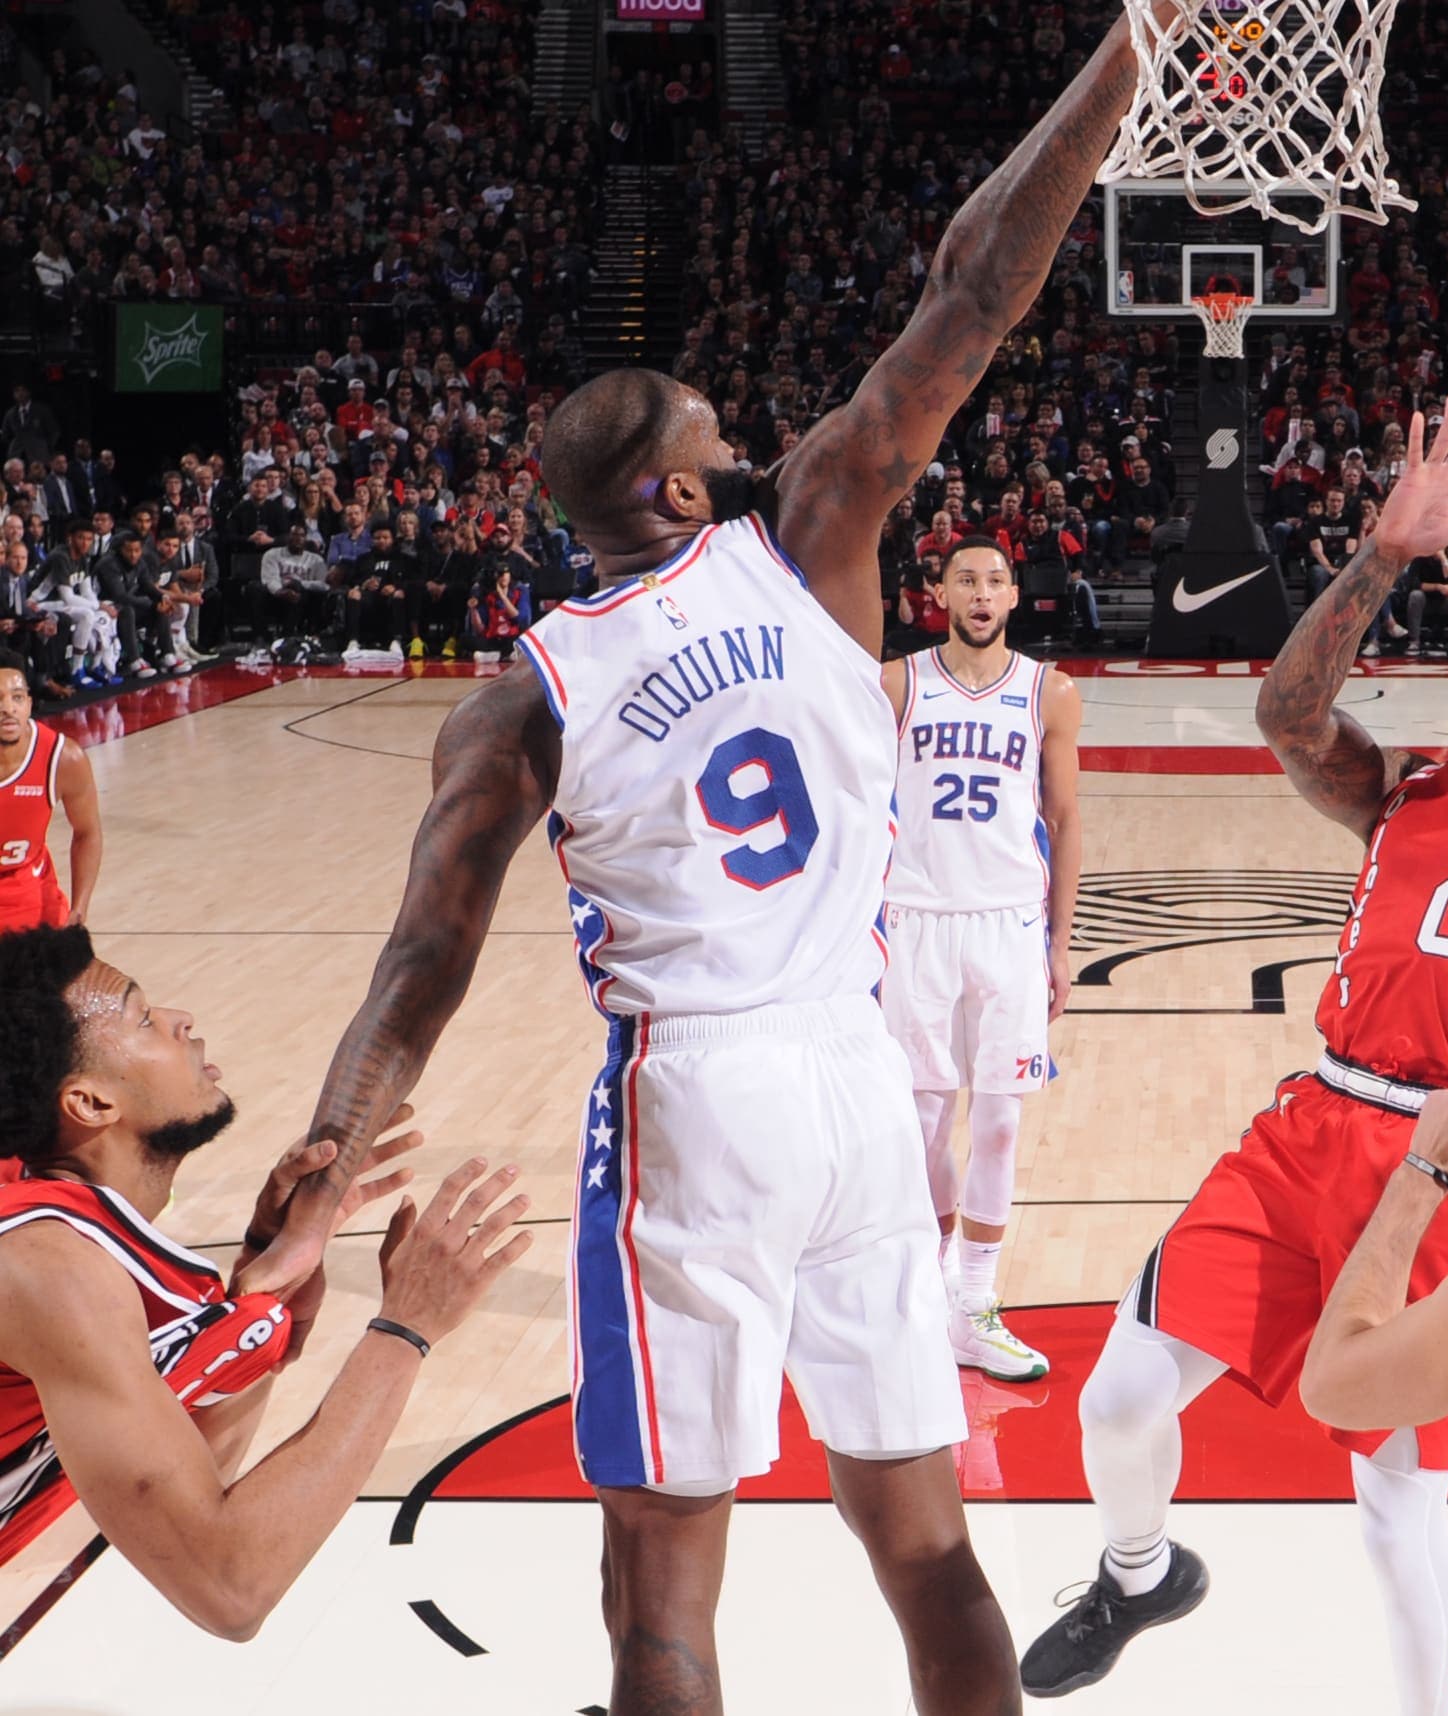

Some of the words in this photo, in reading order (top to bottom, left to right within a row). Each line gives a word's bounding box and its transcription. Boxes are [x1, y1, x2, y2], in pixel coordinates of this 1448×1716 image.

[143, 333, 198, 365] Sprite
[619, 625, 783, 742] O'QUINN
[912, 721, 1027, 772] PHILA
[695, 727, 820, 891] 9
[931, 773, 1001, 823] 25
[0, 839, 30, 866] 3
[1015, 1053, 1043, 1081] 76
